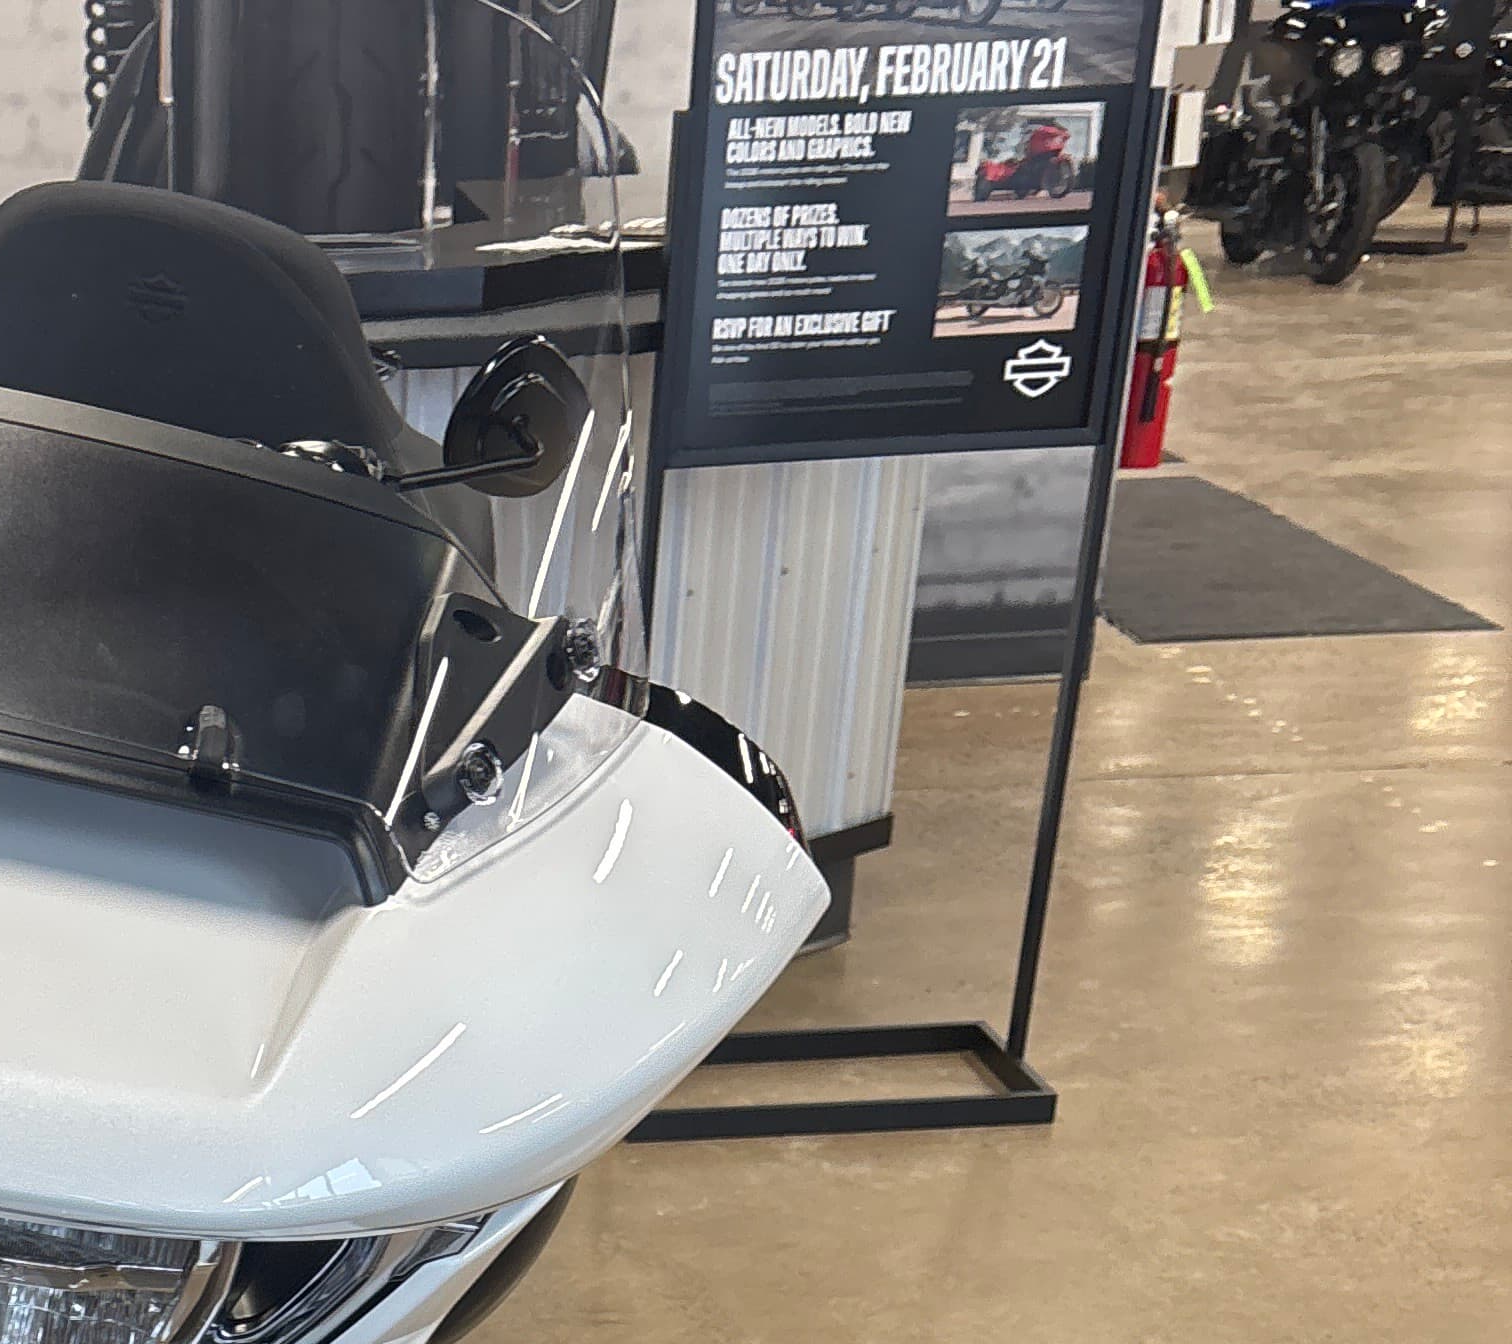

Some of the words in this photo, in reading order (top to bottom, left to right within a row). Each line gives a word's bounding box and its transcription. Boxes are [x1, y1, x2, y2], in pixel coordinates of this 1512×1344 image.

[715, 47, 869, 104] SATURDAY,
[875, 39, 1031, 96] FEBRUARY
[1029, 37, 1068, 89] 21
[727, 117, 786, 140] ALL-NEW
[787, 114, 842, 137] MODELS.
[844, 112, 878, 135] BOLD
[878, 110, 912, 134] NEW
[726, 140, 777, 163] COLORS
[777, 138, 806, 161] AND
[721, 206, 772, 229] DOZENS
[773, 205, 791, 227] OF
[719, 229, 782, 251] MULTIPLE
[782, 227, 818, 249] WAYS
[819, 226, 836, 248] TO
[717, 252, 745, 274] ONE
[746, 251, 771, 273] DAY
[712, 317, 747, 340] RSVP
[747, 315, 773, 338] FOR
[773, 314, 794, 337] AN
[794, 311, 861, 336] EXCLUSIVE
[861, 310, 897, 333] GIFT
